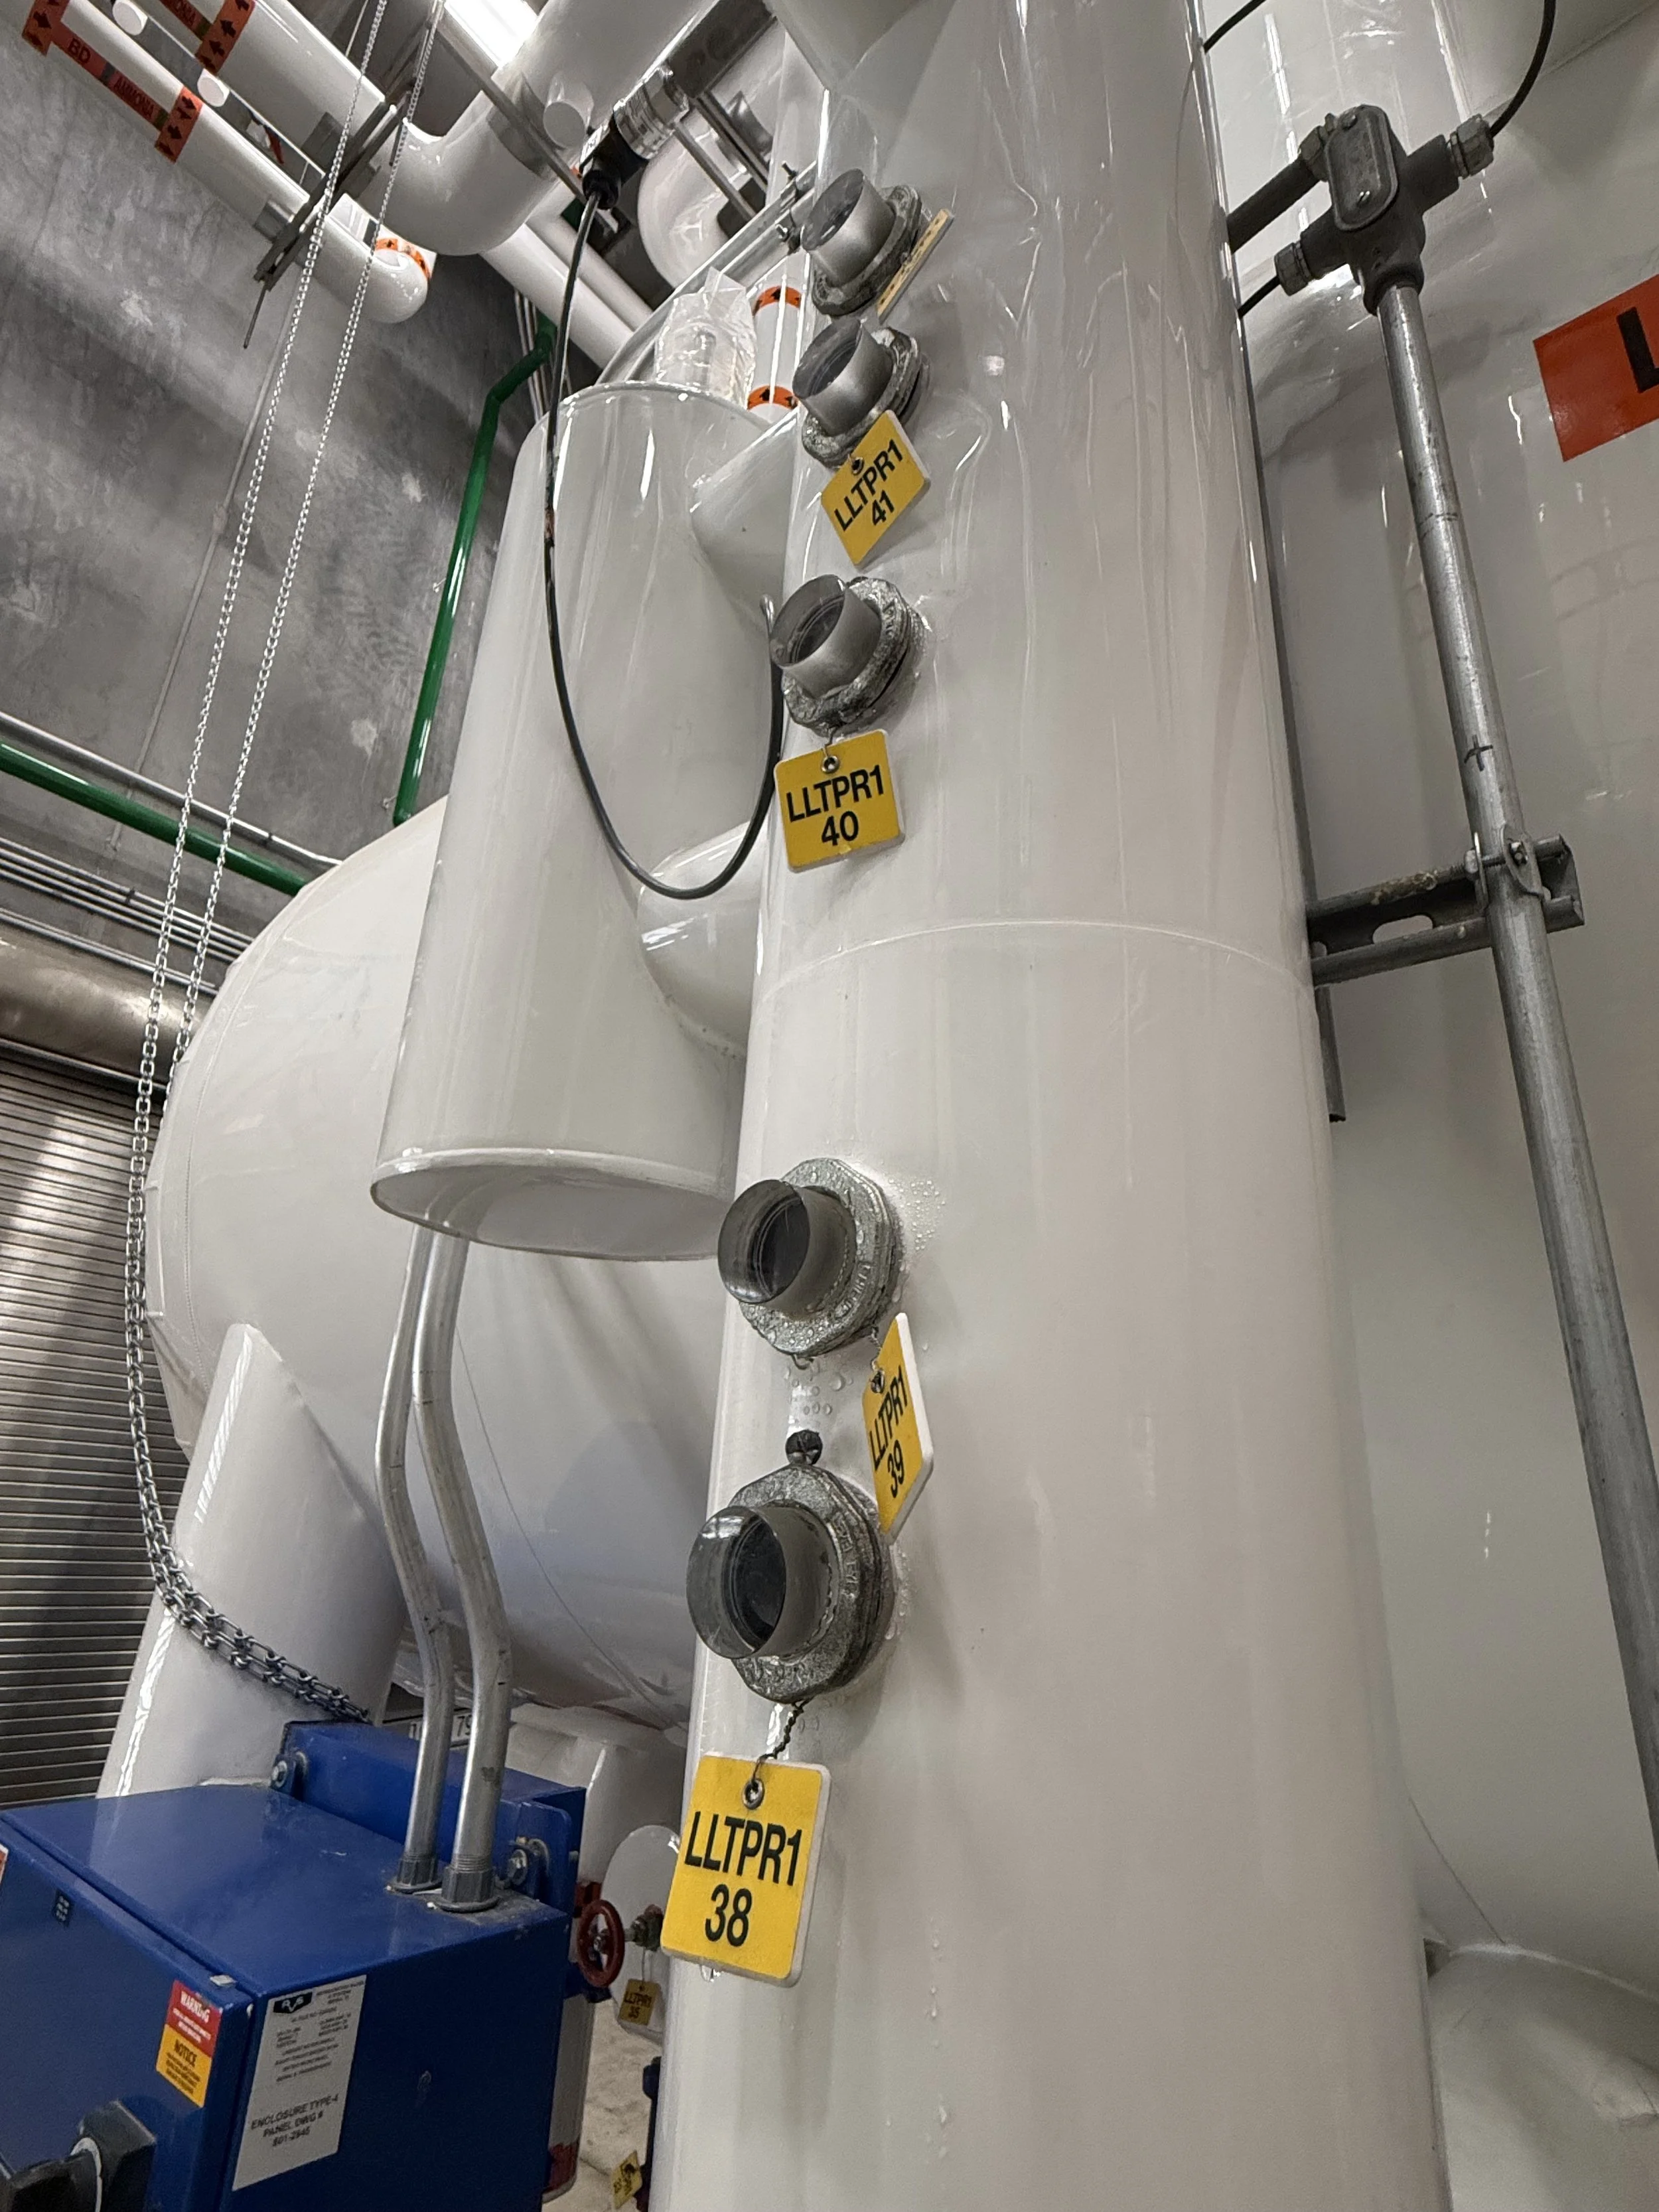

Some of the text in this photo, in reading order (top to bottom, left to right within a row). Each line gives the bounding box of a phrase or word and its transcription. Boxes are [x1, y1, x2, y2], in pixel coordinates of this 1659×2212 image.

[67, 38, 91, 65] BD
[834, 439, 903, 532] LLTPR1
[871, 490, 895, 526] 41
[786, 765, 884, 822] LLTPR1
[822, 811, 859, 846] 40
[869, 1364, 908, 1472] LLTPR1
[887, 1439, 904, 1499] 39
[685, 1810, 802, 1886] LLTPR1
[705, 1883, 753, 1947] 38
[175, 2039, 197, 2067] NOTICE
[251, 2103, 308, 2130] ENCLOSURE
